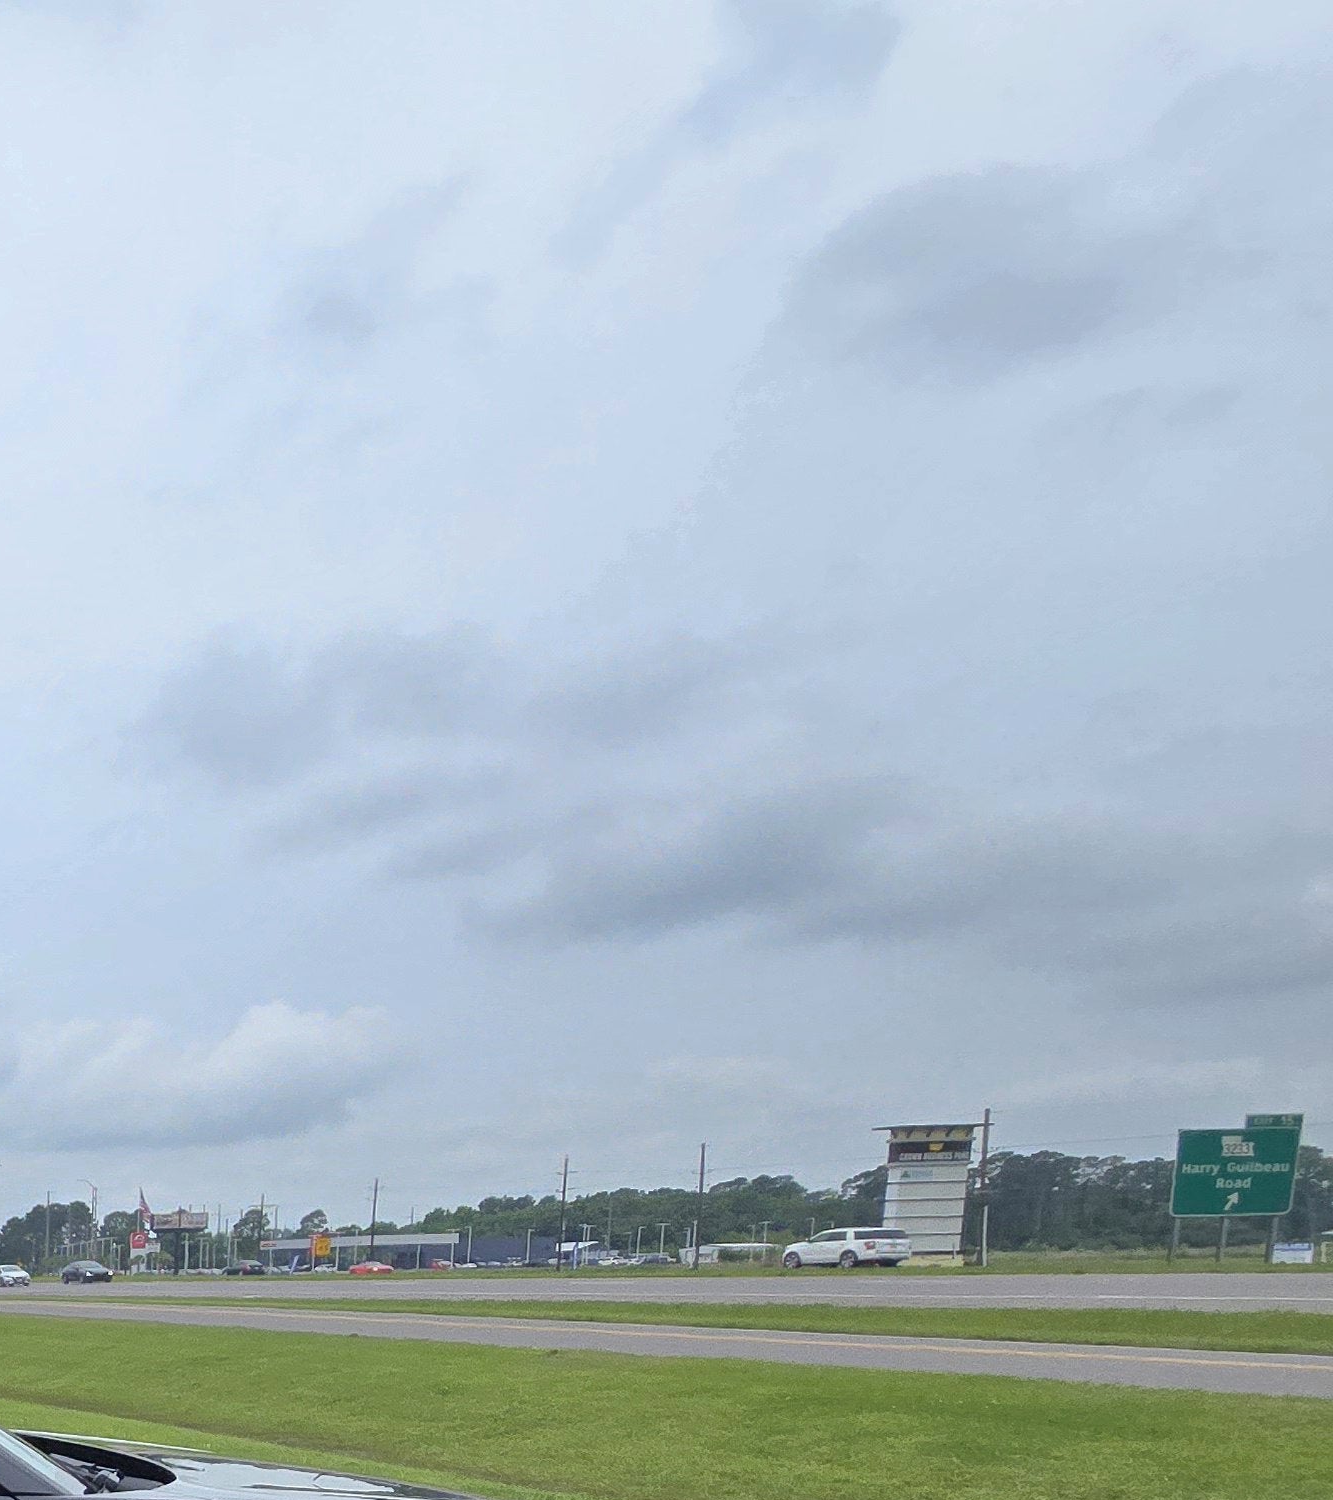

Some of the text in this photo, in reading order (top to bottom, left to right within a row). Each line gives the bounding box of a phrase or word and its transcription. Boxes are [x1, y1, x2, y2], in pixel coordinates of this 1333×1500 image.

[1182, 1161, 1290, 1175] Harry Guilbeau
[1215, 1177, 1252, 1189] Road
